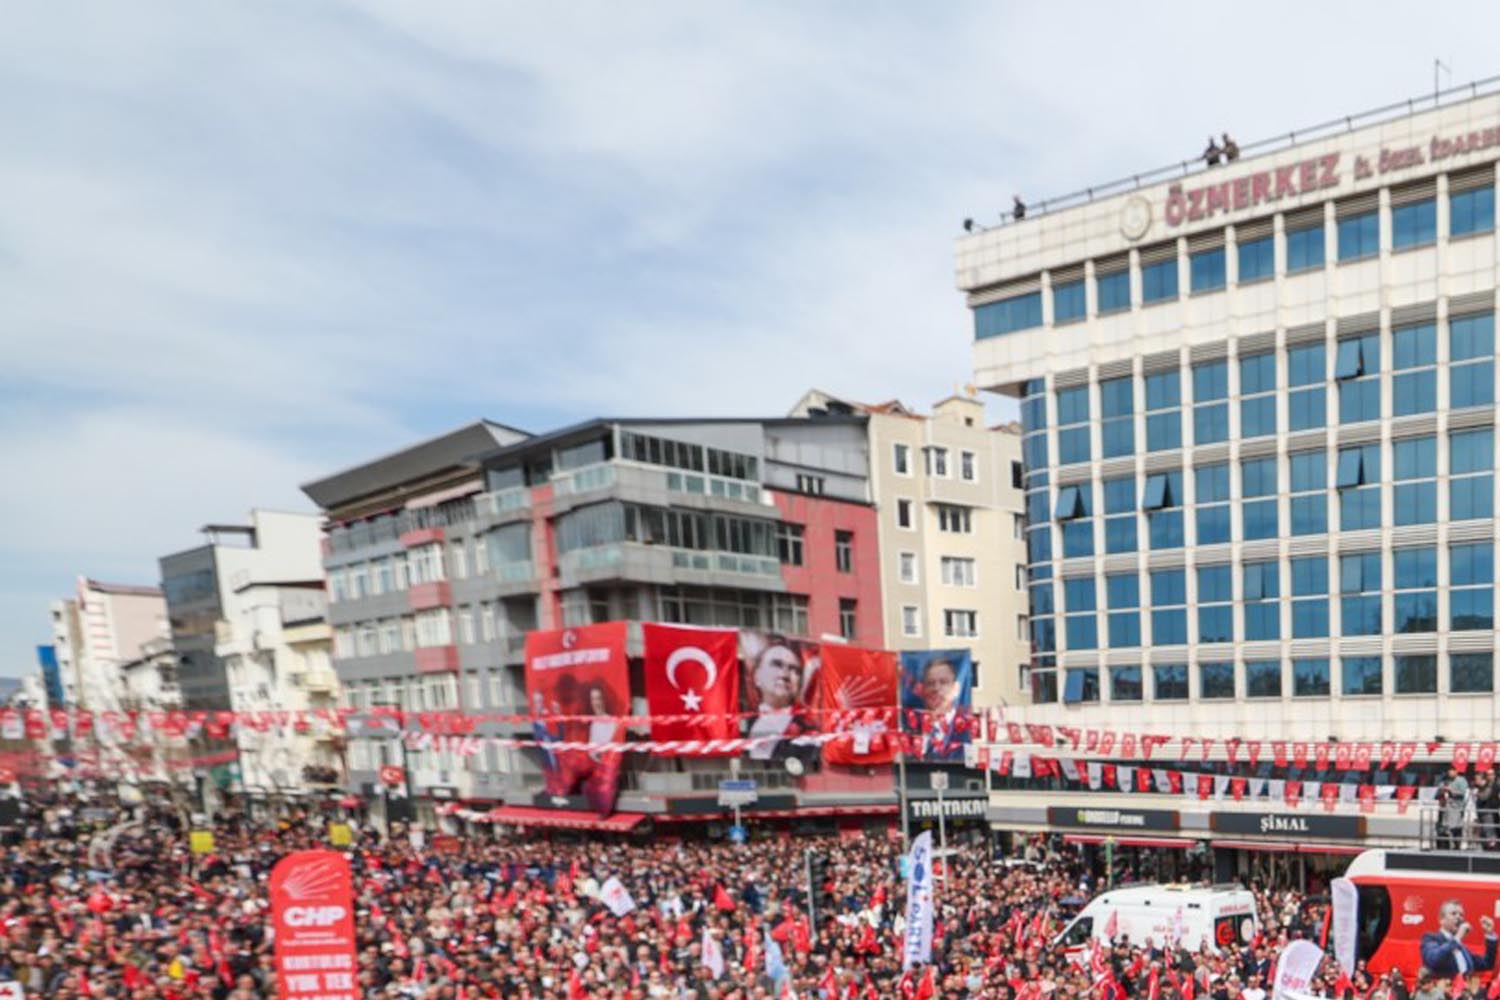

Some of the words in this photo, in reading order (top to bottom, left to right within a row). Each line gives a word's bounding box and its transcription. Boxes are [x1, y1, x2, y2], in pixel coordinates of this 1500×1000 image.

[1165, 151, 1341, 228] ÖZMERKEZ
[1260, 814, 1310, 832] ŞİMAL
[283, 906, 347, 927] CHP
